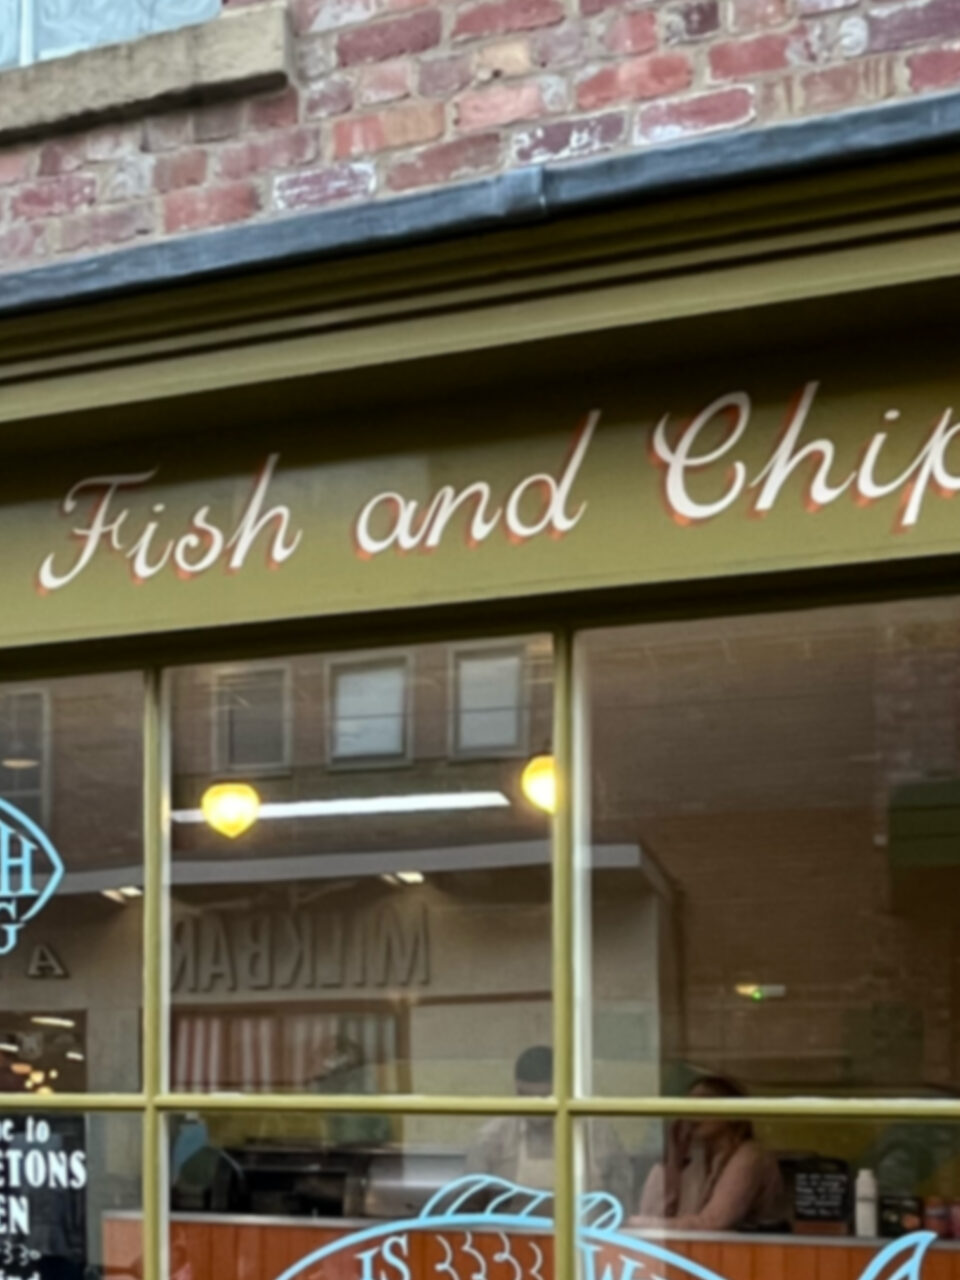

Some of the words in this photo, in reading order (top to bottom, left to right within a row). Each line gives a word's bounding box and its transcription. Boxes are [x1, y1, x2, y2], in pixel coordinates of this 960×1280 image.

[38, 452, 302, 592] Fish
[354, 409, 603, 557] and
[650, 381, 960, 530] Chip
[26, 1116, 50, 1142] to
